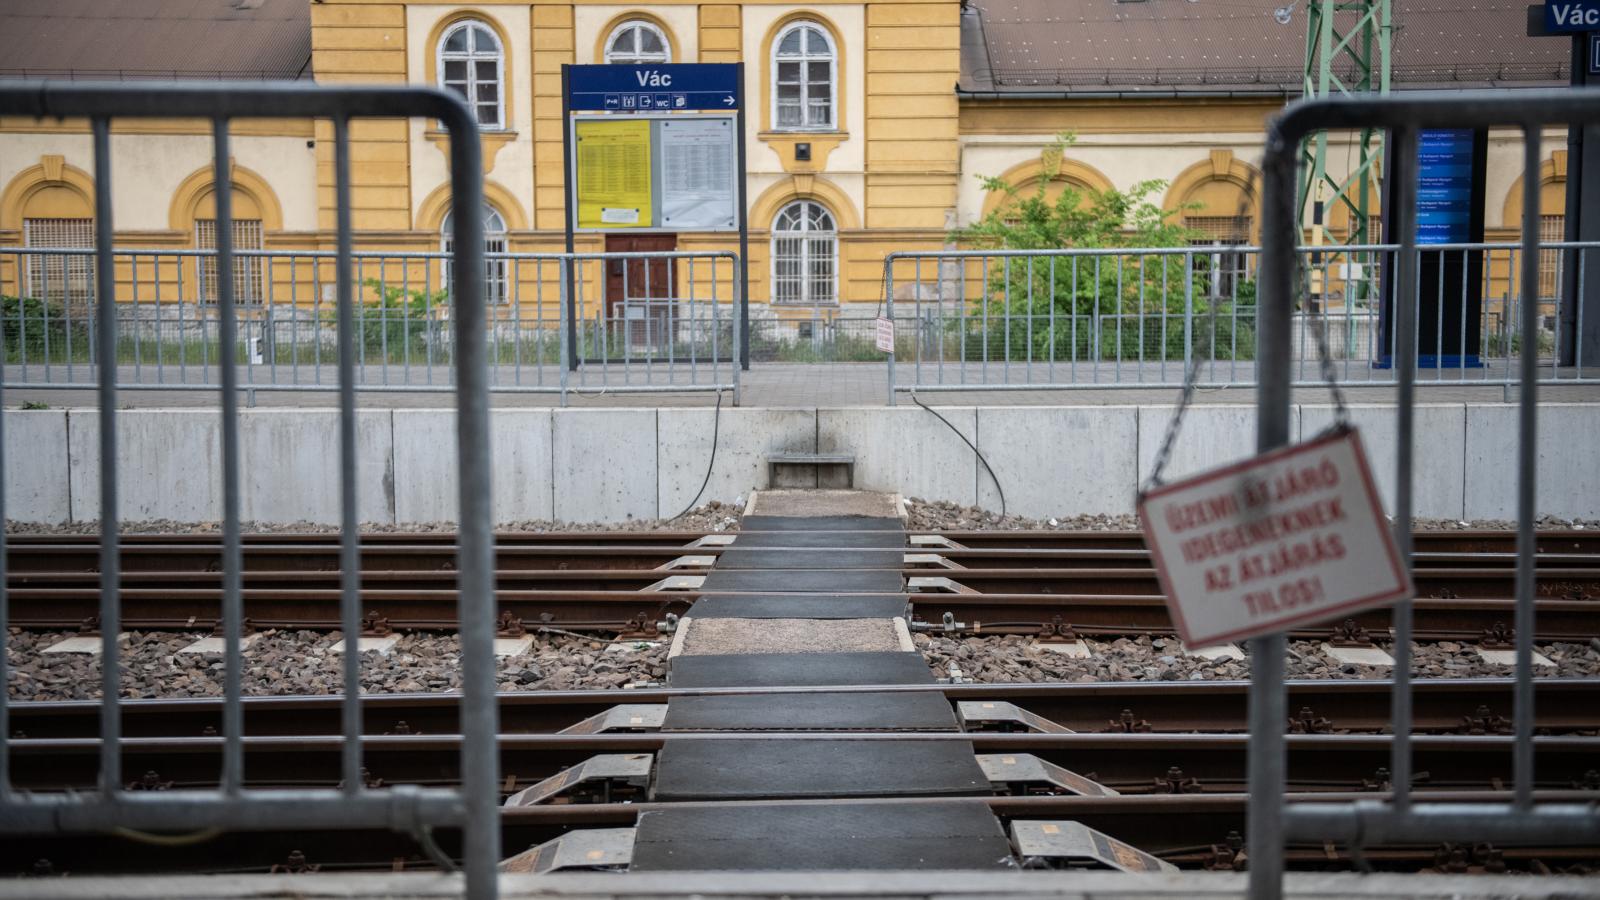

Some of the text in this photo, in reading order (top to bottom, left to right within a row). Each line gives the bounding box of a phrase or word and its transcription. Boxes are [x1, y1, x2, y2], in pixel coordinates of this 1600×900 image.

[1552, 3, 1599, 25] Vác
[635, 70, 672, 87] Vác
[1166, 495, 1238, 532] ÜZEMI
[1182, 498, 1345, 563] IDEGENEKNEK
[1204, 534, 1346, 592] AZ ÁTJÁRÁS
[1243, 578, 1323, 615] TILOS!
